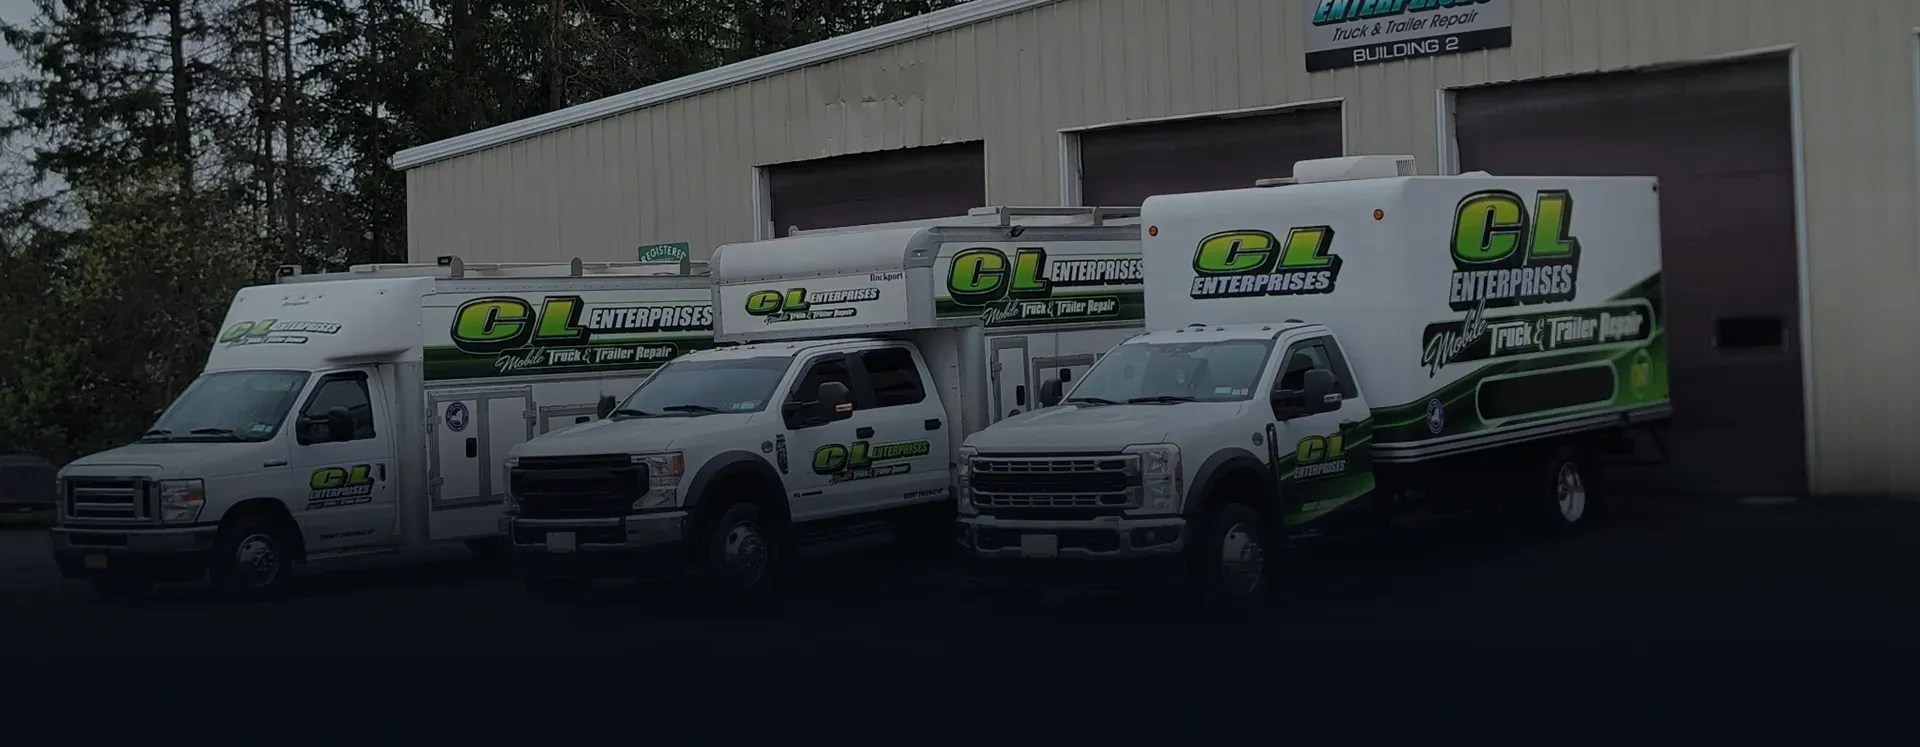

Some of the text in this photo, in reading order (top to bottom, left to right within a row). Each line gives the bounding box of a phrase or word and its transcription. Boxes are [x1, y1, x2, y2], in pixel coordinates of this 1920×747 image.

[1332, 25, 1366, 41] Truck
[1371, 23, 1381, 35] &
[1386, 17, 1427, 34] Trailer
[1430, 10, 1479, 29] Repair
[1353, 36, 1459, 62] BUILDING 2
[1451, 189, 1580, 266] CL
[1193, 225, 1343, 275] CL
[870, 273, 903, 282] Rockport
[947, 247, 1143, 304] CL ENTERPRISES
[1191, 270, 1334, 298] ENTERPRISES
[1451, 264, 1574, 305] ENTERPRISES
[745, 287, 880, 315] CL ENTERPRISES
[982, 299, 1115, 326] Mobile Truck & Trailer Repair
[452, 296, 713, 350] CL ENTERPRISES
[1422, 300, 1643, 378] Mobile Truck & Trailer Repair
[494, 344, 673, 373] Mobile Truck & Trailer Repair
[812, 441, 871, 475] CL
[1295, 432, 1347, 463] CL
[309, 464, 374, 490] CL
[1293, 460, 1346, 479] ENTERPRISES
